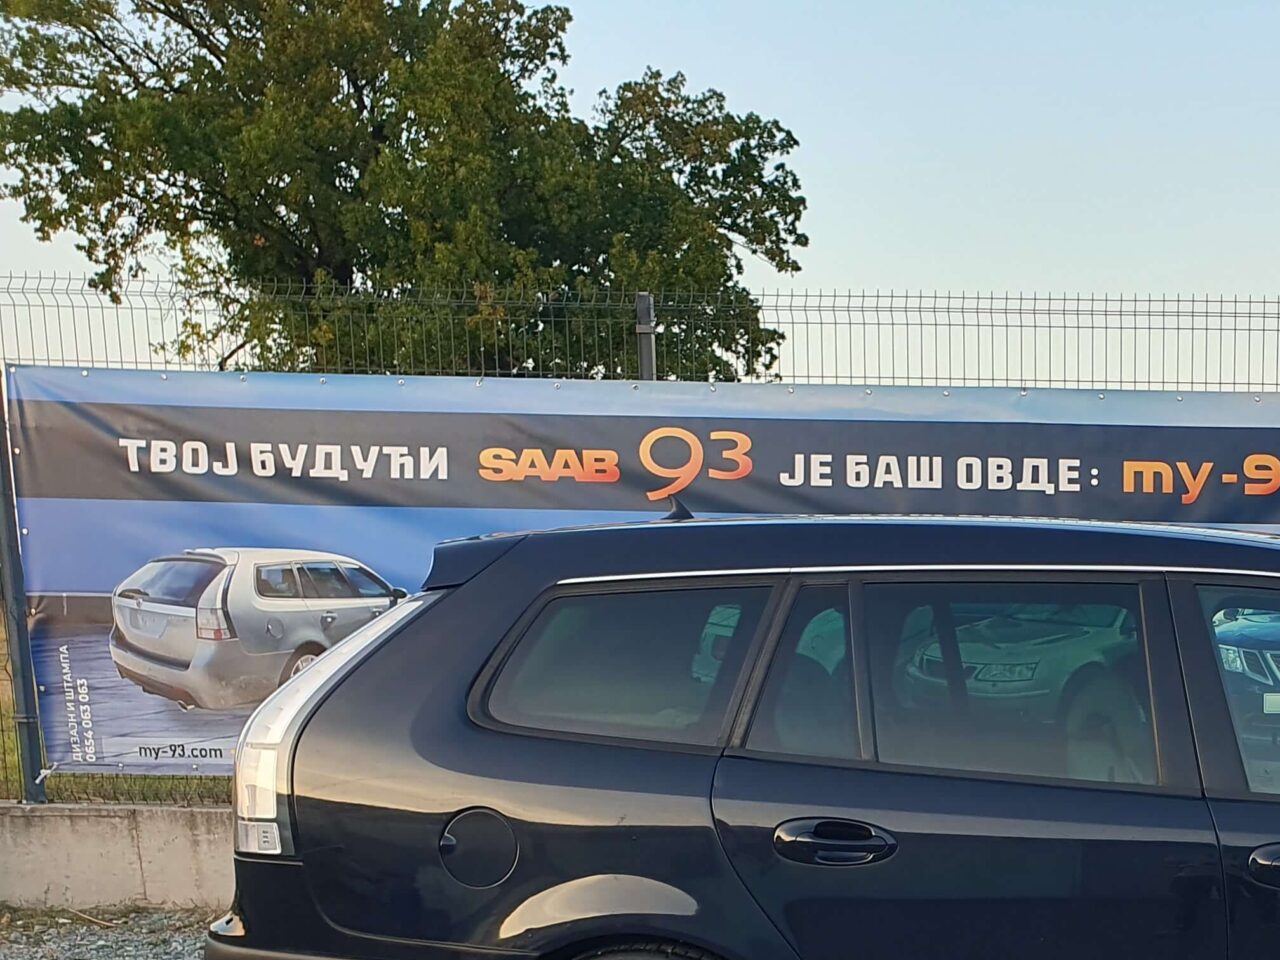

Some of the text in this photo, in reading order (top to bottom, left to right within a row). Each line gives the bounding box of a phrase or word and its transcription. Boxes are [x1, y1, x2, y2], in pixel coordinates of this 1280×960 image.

[118, 438, 238, 476] ТВОЈ
[250, 442, 448, 481] БУДУЋИ
[478, 447, 620, 482] SAAB
[638, 426, 753, 501] 93
[779, 454, 833, 487] ЈЕ
[846, 455, 943, 489] БАШ
[59, 644, 83, 762] ДИЗАЈН И ШТАМПА
[77, 679, 97, 762] 0654 063 063
[138, 744, 223, 760] my-93.com
